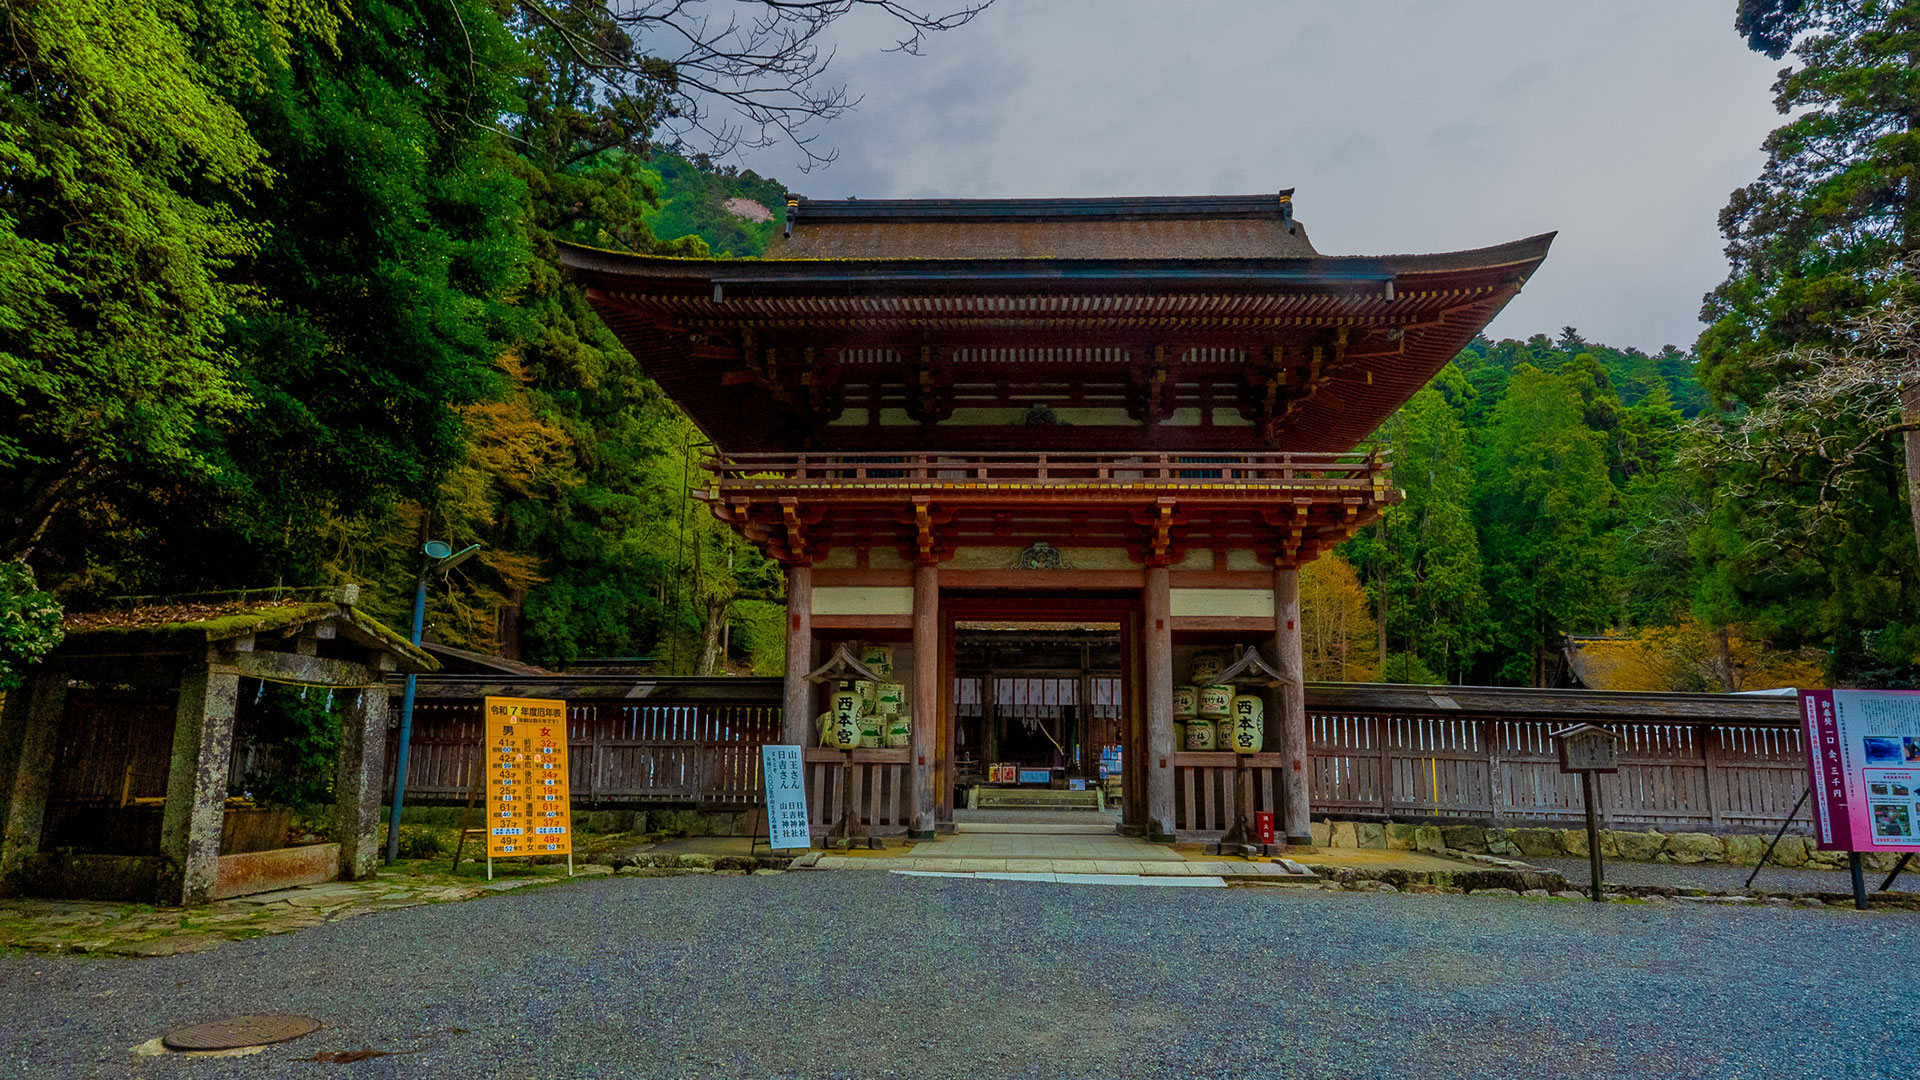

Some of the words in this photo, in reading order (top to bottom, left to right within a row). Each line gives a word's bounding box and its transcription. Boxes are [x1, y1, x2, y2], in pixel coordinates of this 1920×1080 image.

[1203, 695, 1225, 704] 松竹梅
[490, 705, 562, 718] 令和7年度厄年表
[837, 696, 853, 744] 西本宮
[1236, 699, 1255, 748] 西本宮
[502, 725, 514, 736] 男
[539, 726, 551, 737] 女
[1825, 730, 1835, 744] 一口
[498, 738, 516, 747] 41才
[540, 739, 557, 748] 32才
[498, 754, 516, 762] 42才
[523, 754, 532, 769] 本厄
[541, 754, 557, 763] 33才
[499, 770, 516, 778] 43才
[541, 770, 558, 778] 34才
[777, 750, 789, 790] 日吉さん
[787, 750, 800, 790] 山王さん
[499, 786, 517, 795] 25才
[543, 786, 558, 794] 19才
[499, 803, 518, 811] 61才
[542, 802, 559, 811] 61才
[500, 819, 518, 828] 37才
[543, 819, 560, 827] 37才
[779, 801, 791, 838] 山王神社
[788, 801, 799, 838] 日吉神社
[796, 801, 807, 837] 日枝神社
[500, 837, 518, 845] 49才
[543, 835, 561, 844] 49才
